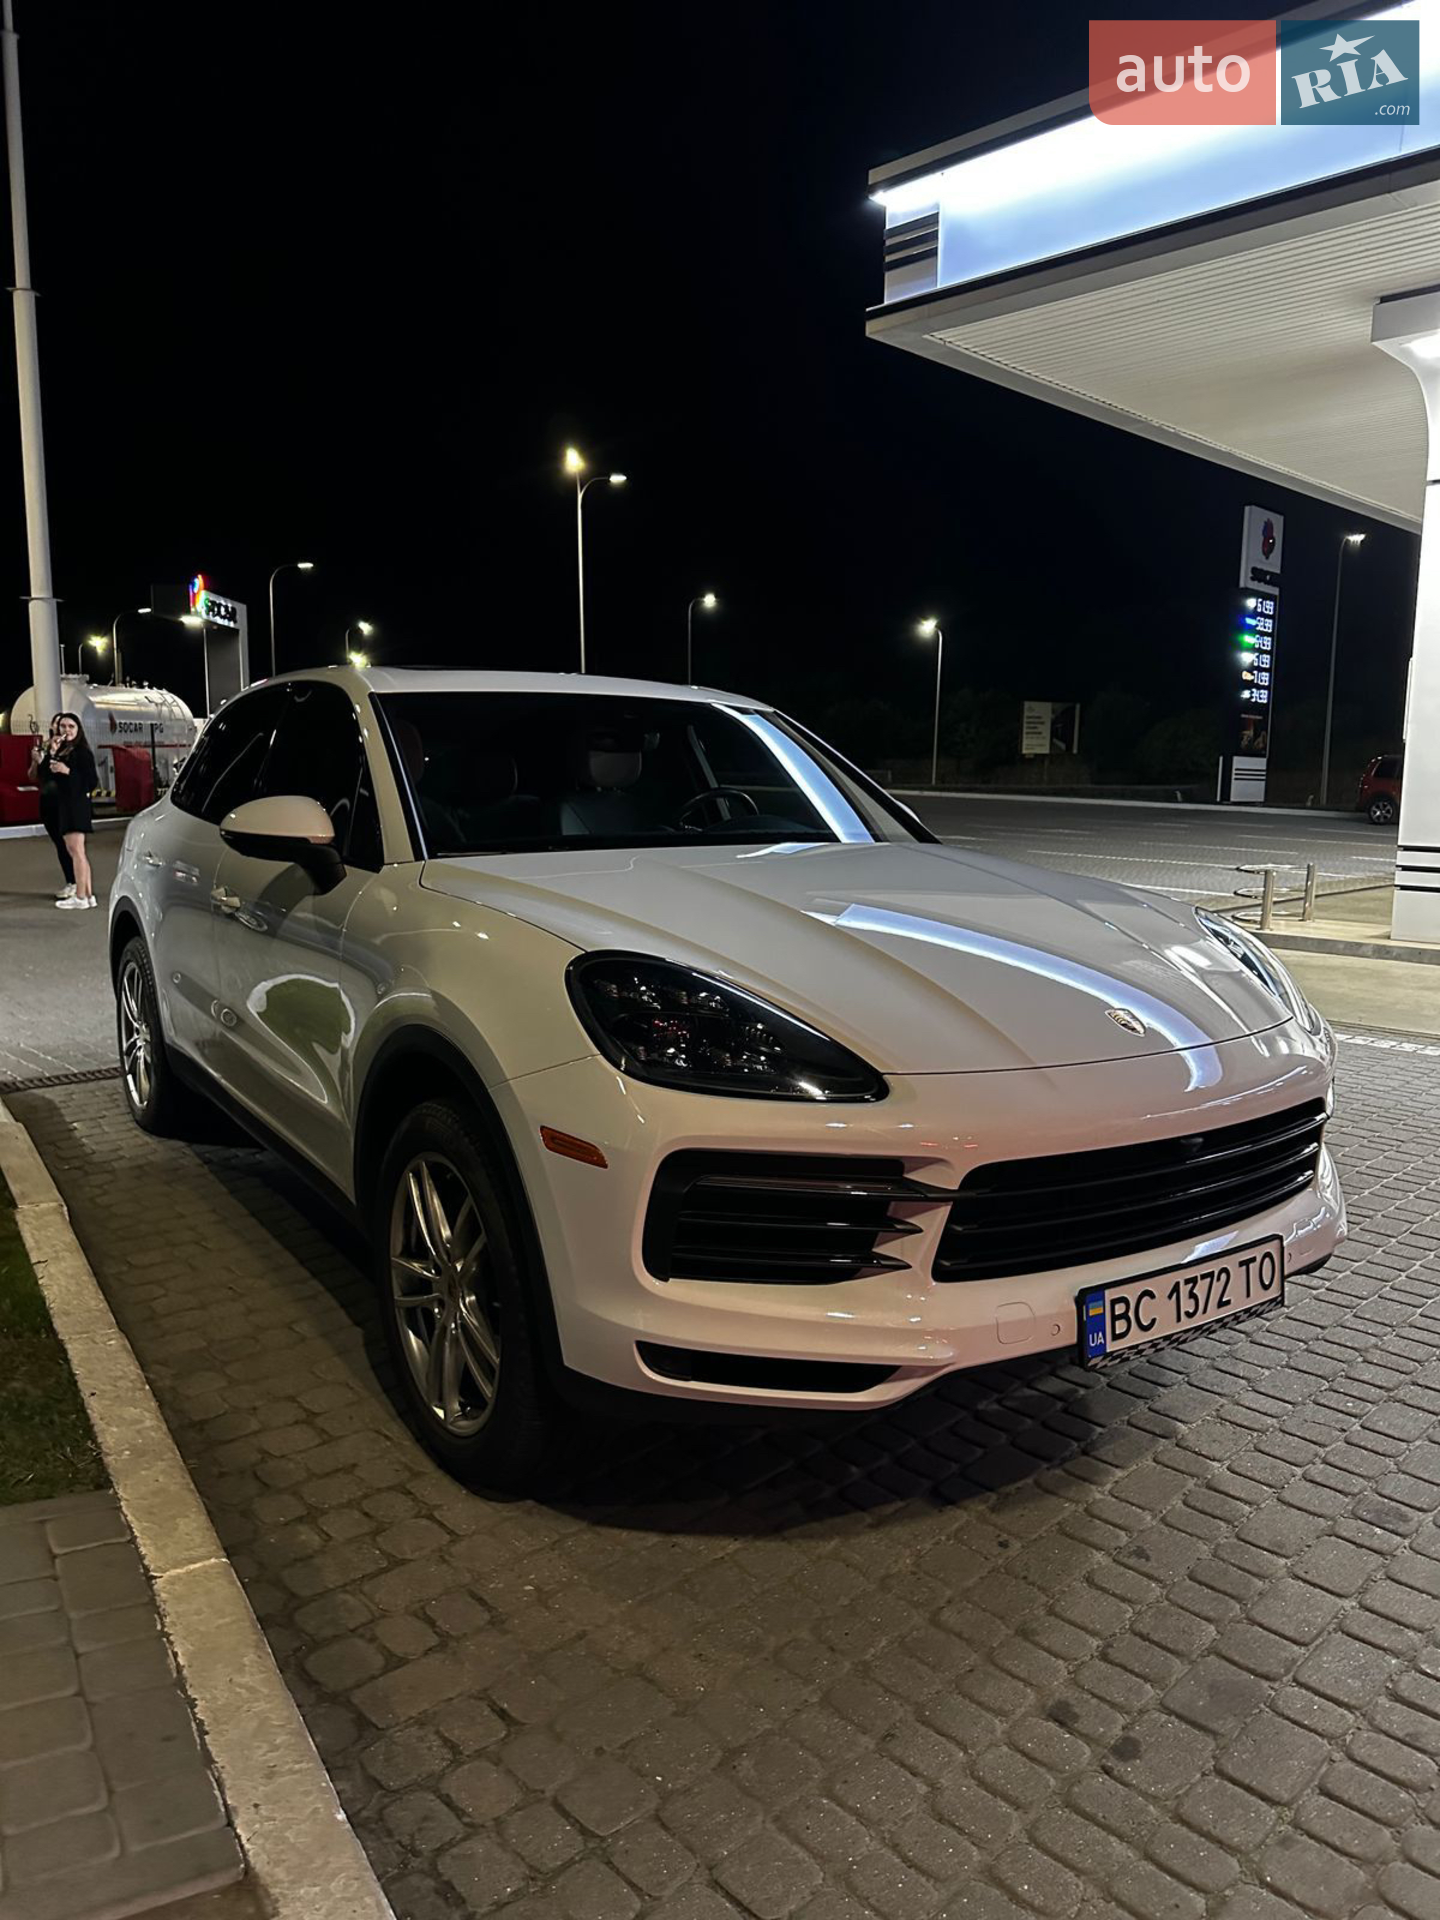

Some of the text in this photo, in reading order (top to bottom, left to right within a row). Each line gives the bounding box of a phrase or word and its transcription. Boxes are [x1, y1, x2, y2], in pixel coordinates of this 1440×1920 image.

[118, 721, 164, 734] SOCAR PG
[1110, 1251, 1276, 1342] BC 1372 TO
[1089, 1331, 1105, 1347] UA
